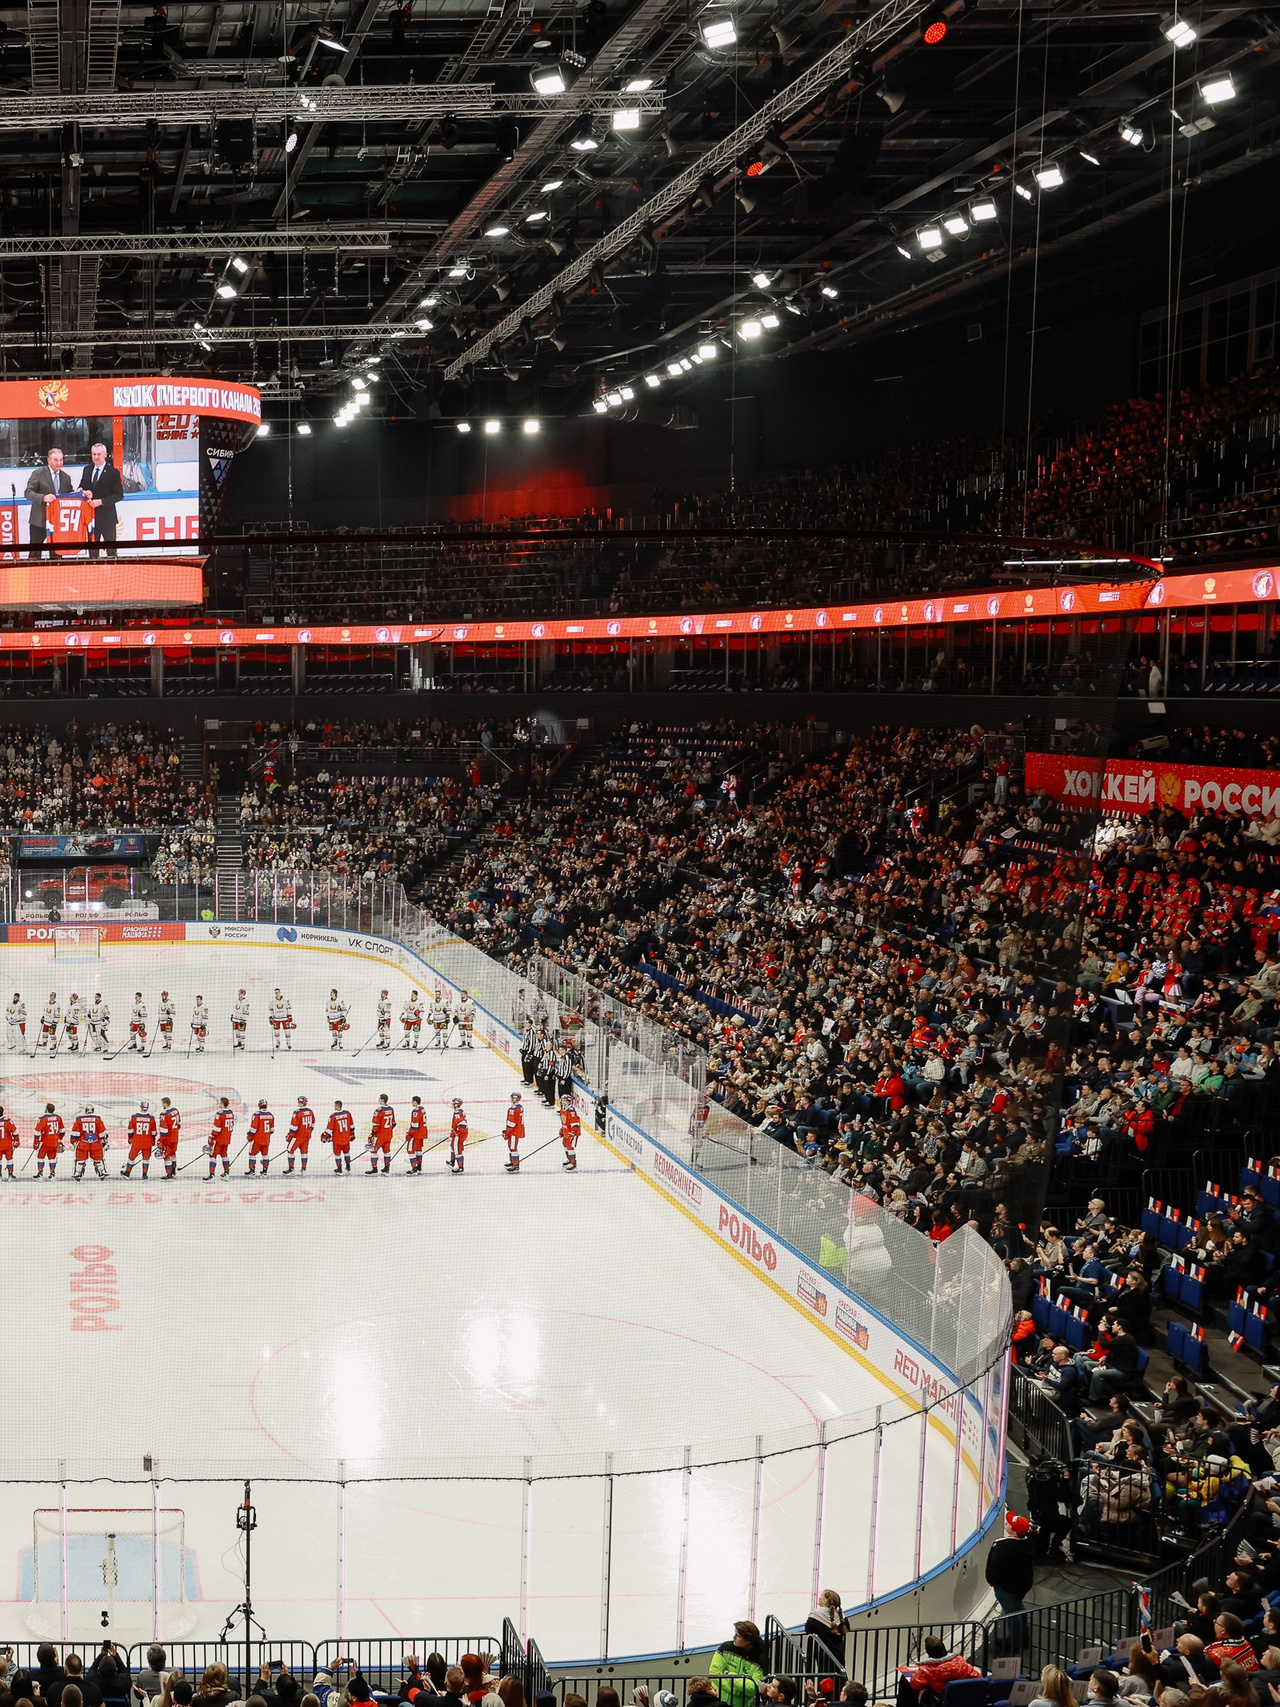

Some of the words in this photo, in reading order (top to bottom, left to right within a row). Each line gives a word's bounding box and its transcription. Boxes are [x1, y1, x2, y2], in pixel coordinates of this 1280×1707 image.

[222, 390, 252, 414] КАНАЛА
[60, 509, 81, 532] 54
[1, 510, 14, 560] РОЛ
[1063, 770, 1156, 804] ХОККЕЙ
[26, 928, 80, 940] РОЛЬФ
[301, 934, 338, 943] НОРНИКЕЛЬ
[348, 938, 362, 948] VK
[364, 942, 394, 956] СПОРТ
[47, 1122, 59, 1134] 34
[82, 1122, 96, 1133] 99
[136, 1122, 150, 1135] 89
[264, 1120, 270, 1133] 6
[302, 1116, 312, 1128] 44
[338, 1120, 348, 1132] 14
[106, 1190, 326, 1204] КРАСНАЯ
[719, 1204, 778, 1272] РОЛЬФ
[69, 1244, 121, 1332] РОЛЬФ
[894, 1348, 919, 1386] RED
